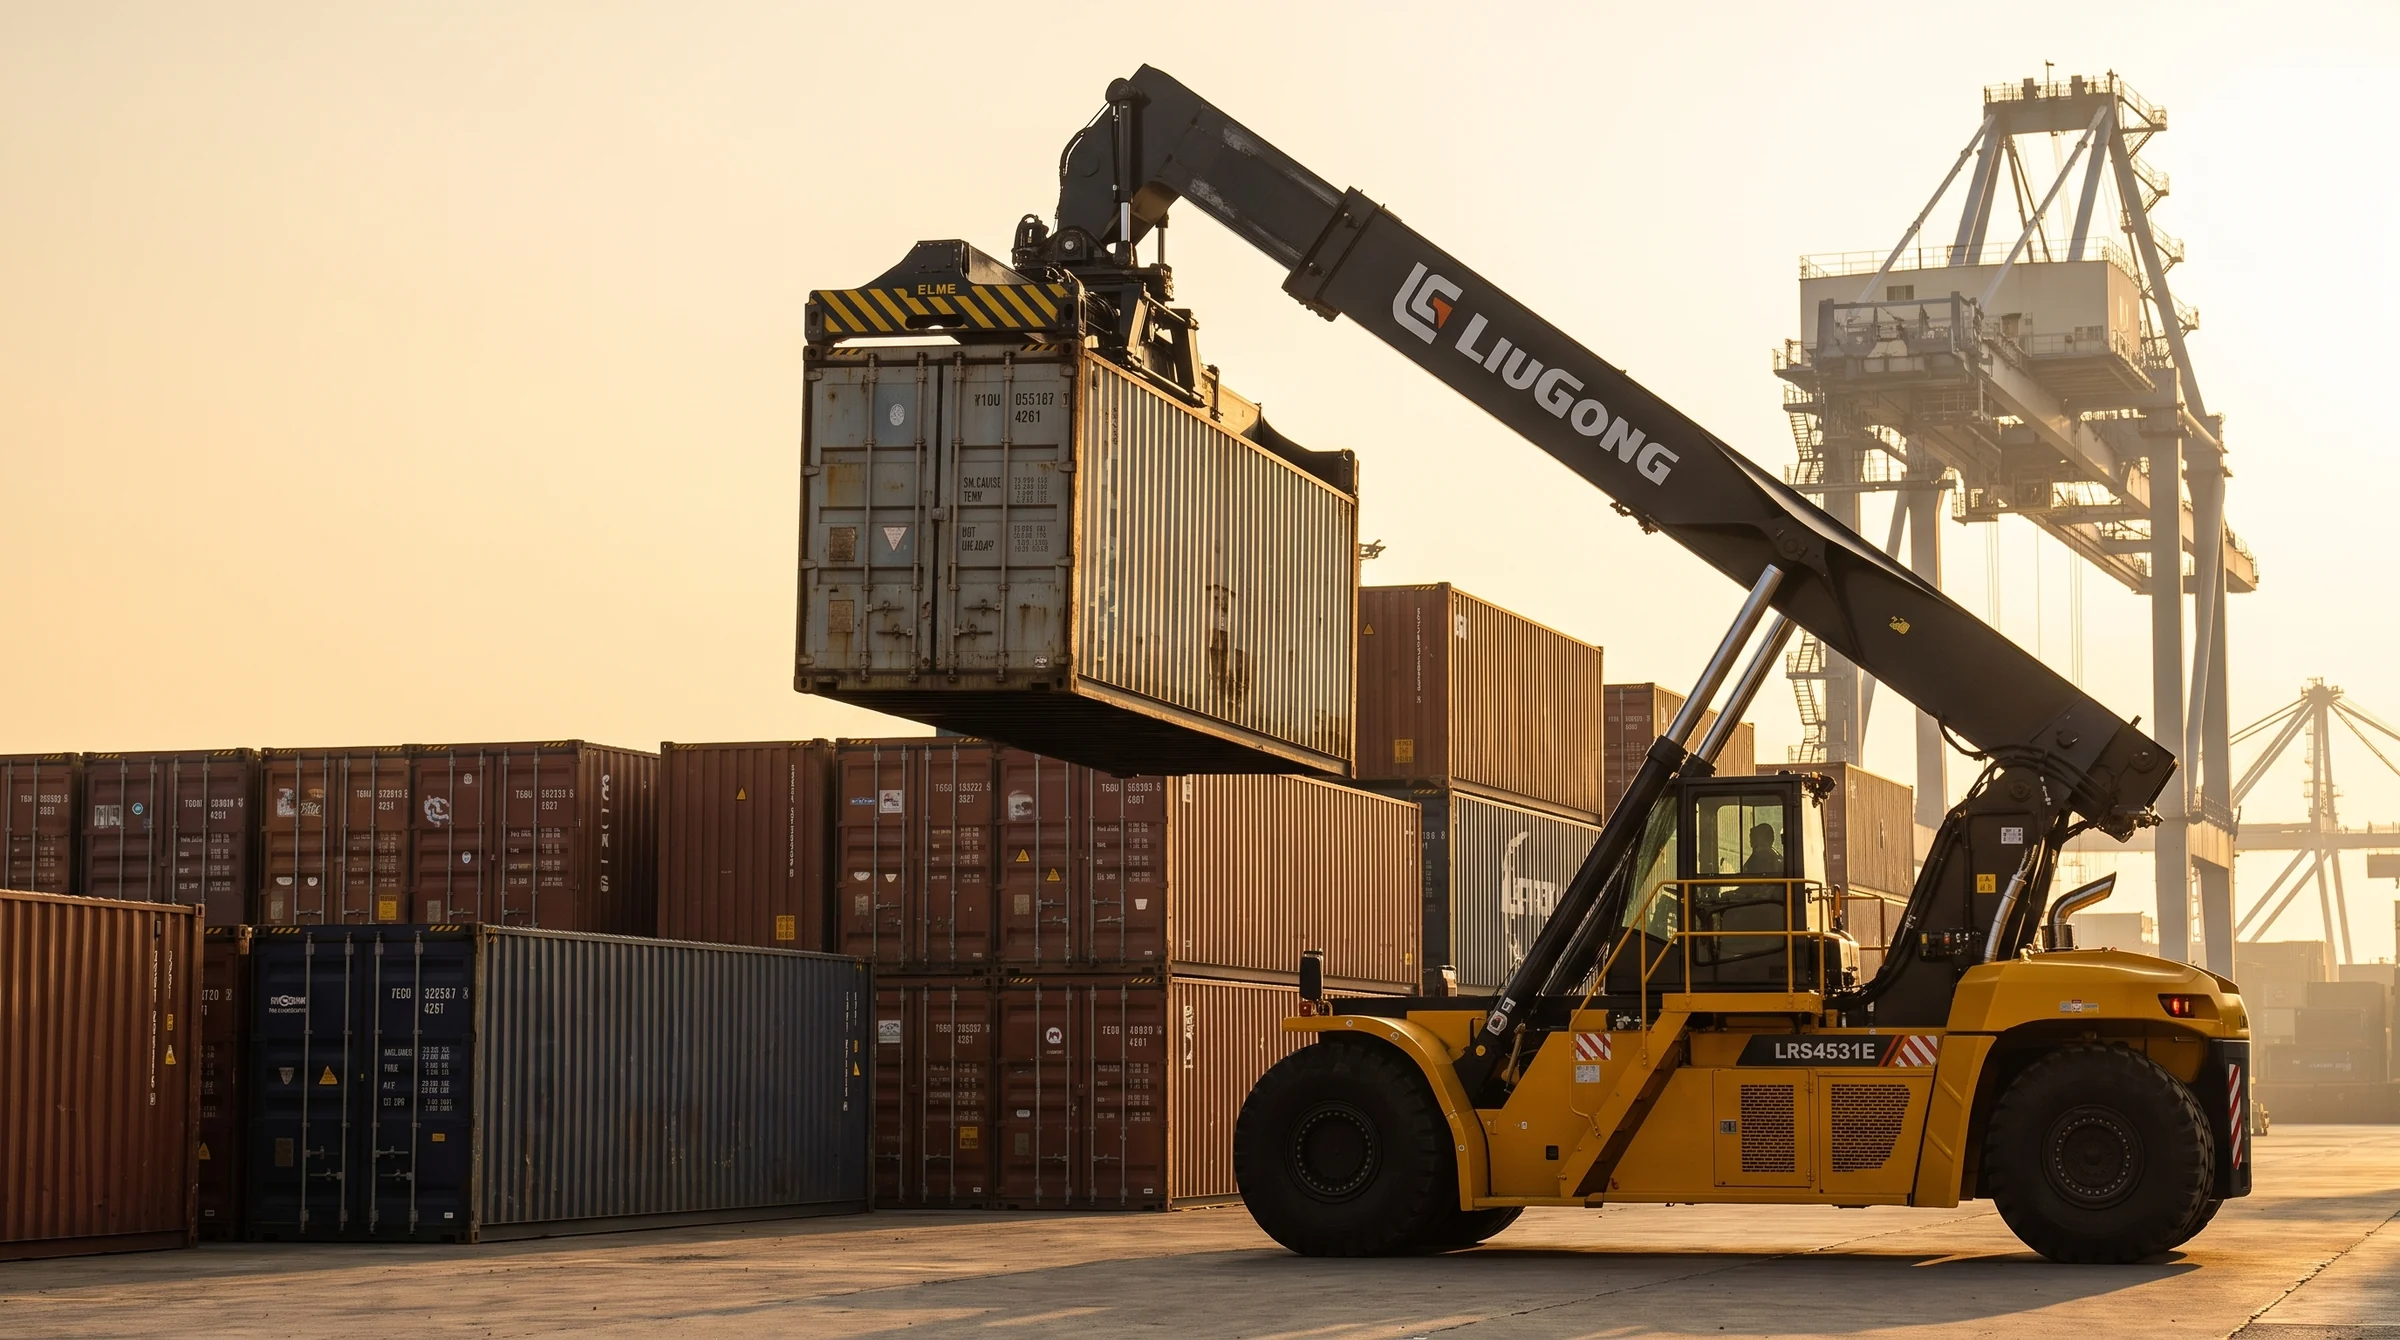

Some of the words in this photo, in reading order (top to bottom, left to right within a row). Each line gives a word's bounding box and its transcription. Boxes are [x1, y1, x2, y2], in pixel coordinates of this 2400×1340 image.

[917, 284, 956, 295] ELME
[1015, 410, 1041, 423] 4261
[1775, 1042, 1876, 1060] LRS4531E
